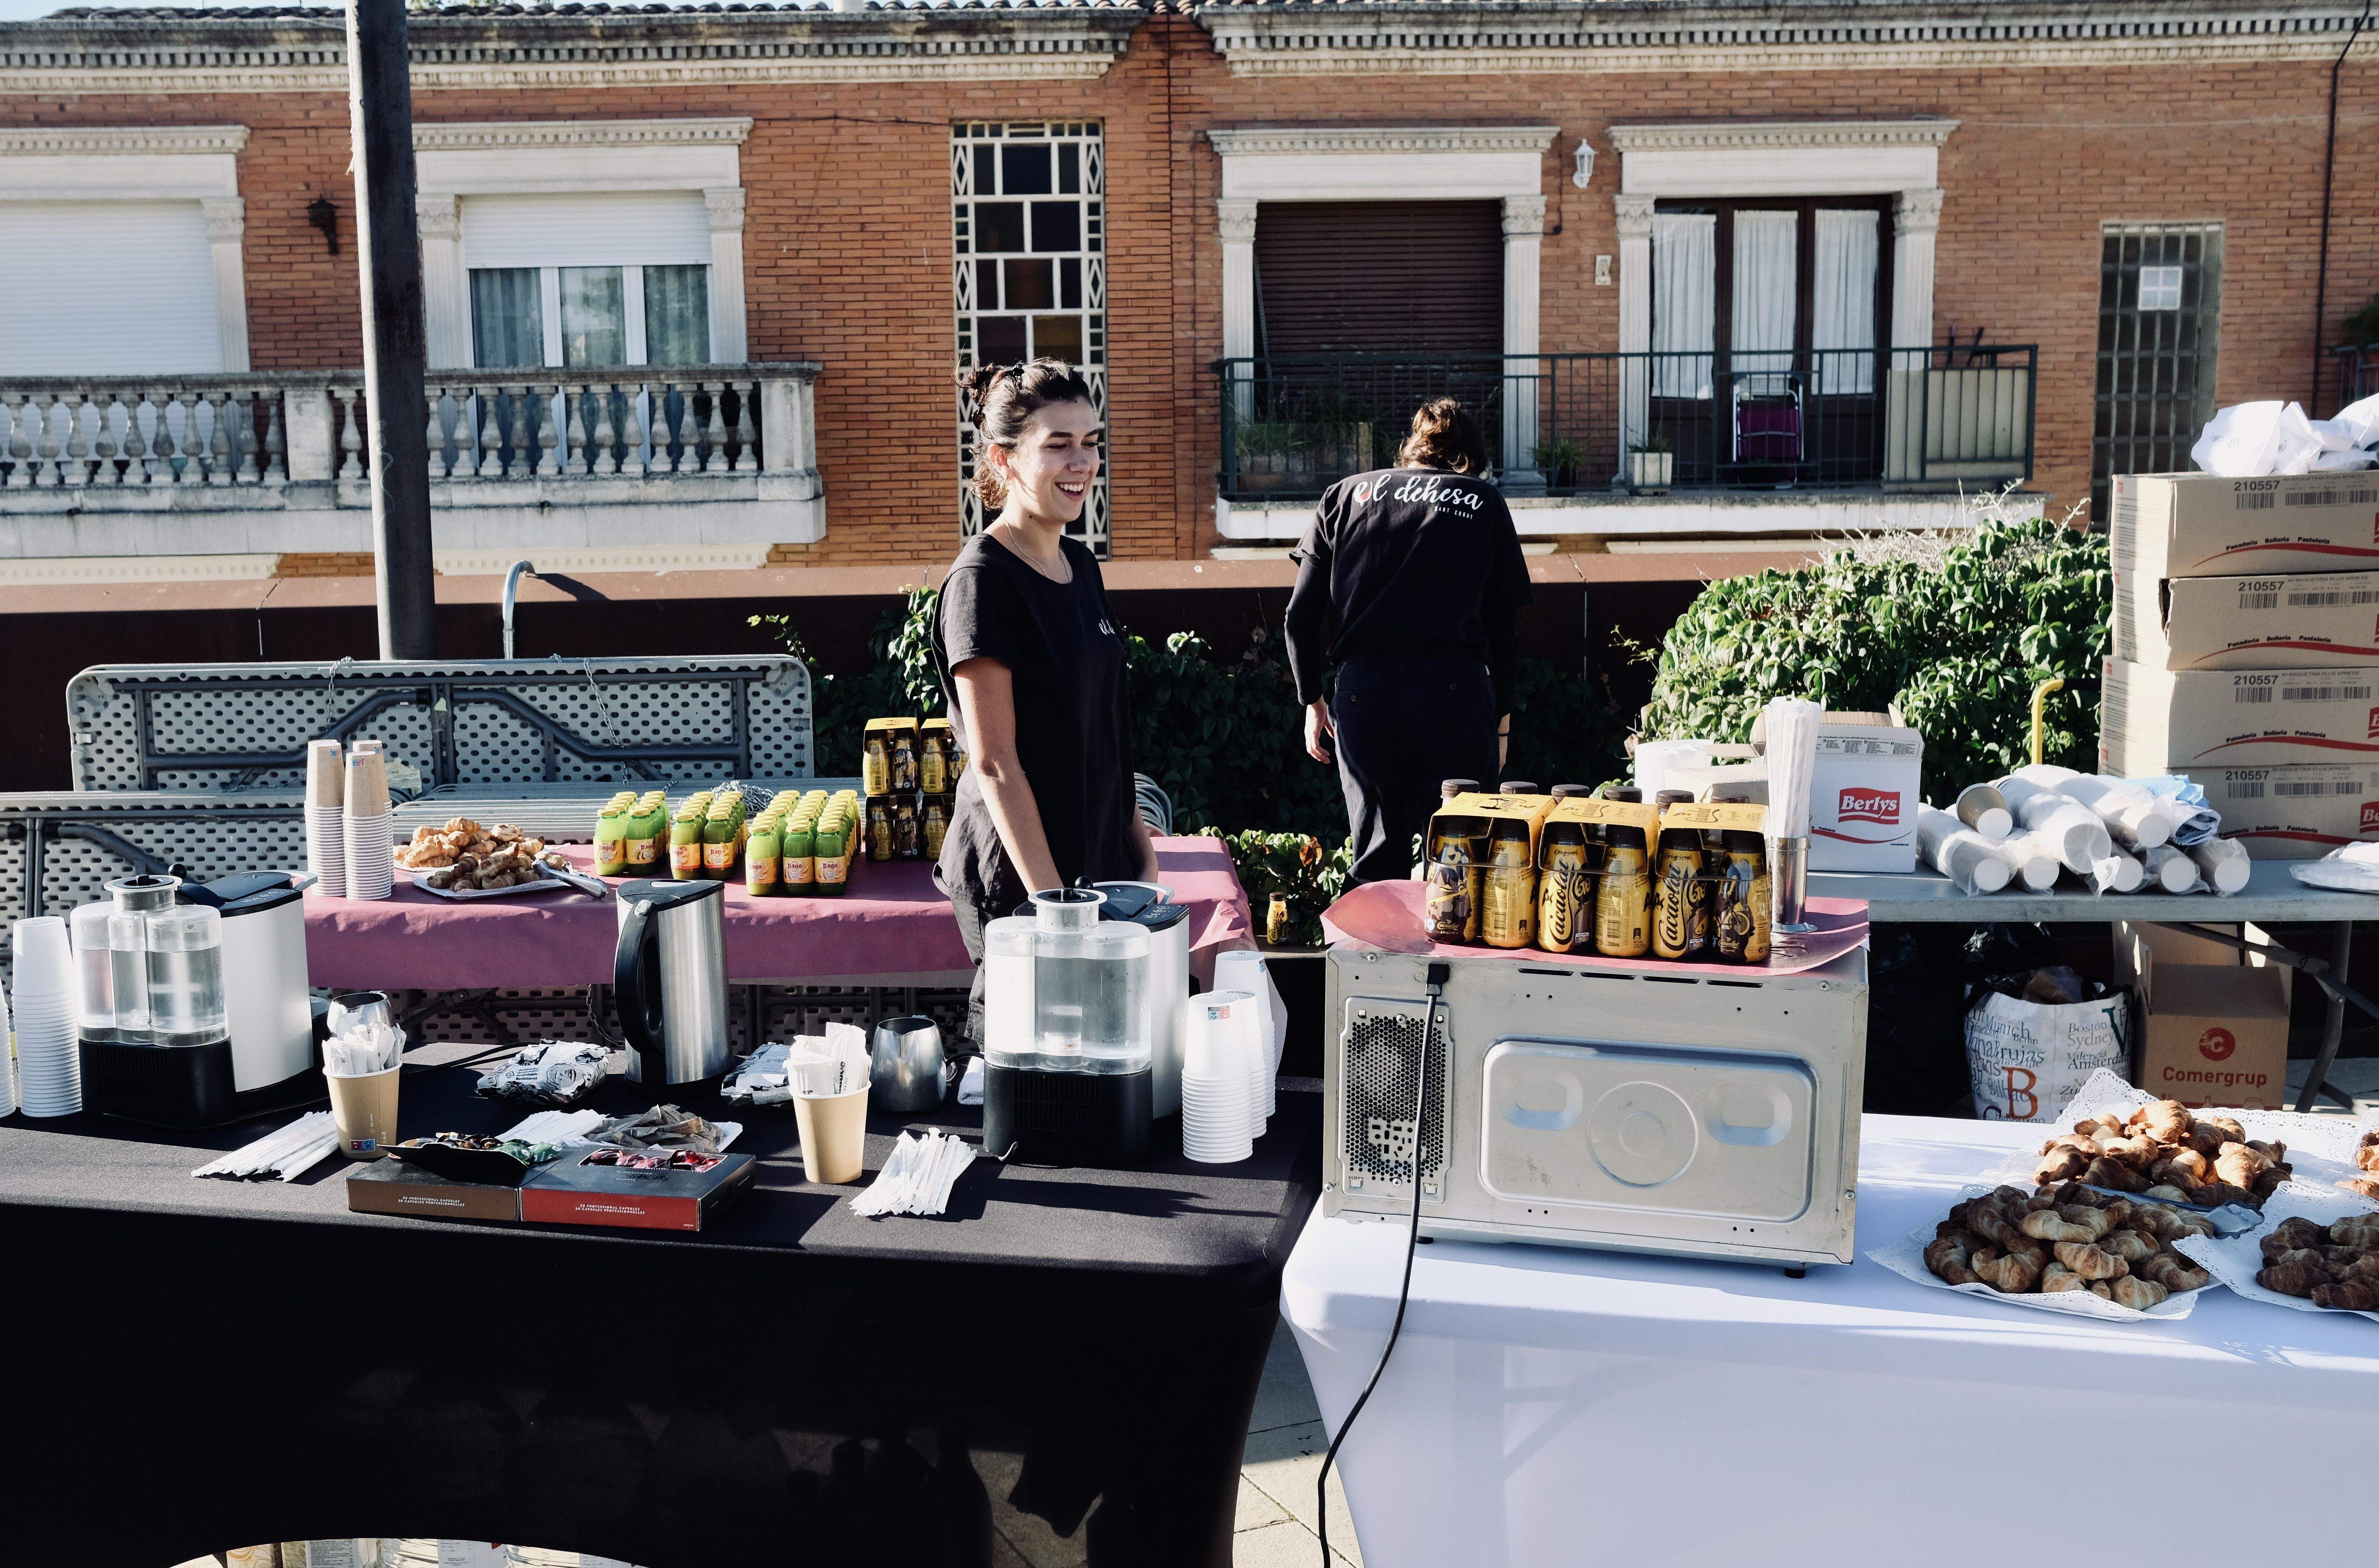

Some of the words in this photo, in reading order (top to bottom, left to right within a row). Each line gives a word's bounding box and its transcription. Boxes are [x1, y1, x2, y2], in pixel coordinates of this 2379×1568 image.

[1394, 475, 1483, 510] dehesa
[2234, 481, 2280, 491] 210557
[2238, 581, 2284, 591] 210557
[2234, 675, 2278, 685] 210557
[2225, 771, 2269, 781] 210557
[1841, 795, 1897, 818] Berlys
[1549, 858, 1574, 945] Cacaolat
[1659, 861, 1688, 951] Cacaolat
[2068, 1021, 2108, 1032] Boston
[2014, 1033, 2038, 1045] Berlin
[2067, 1032, 2114, 1050] Sydney
[2067, 1051, 2107, 1060] Valencia
[2163, 1066, 2267, 1088] Comergrup
[1988, 1078, 2031, 1102] Bilbao
[2001, 1066, 2038, 1120] B
